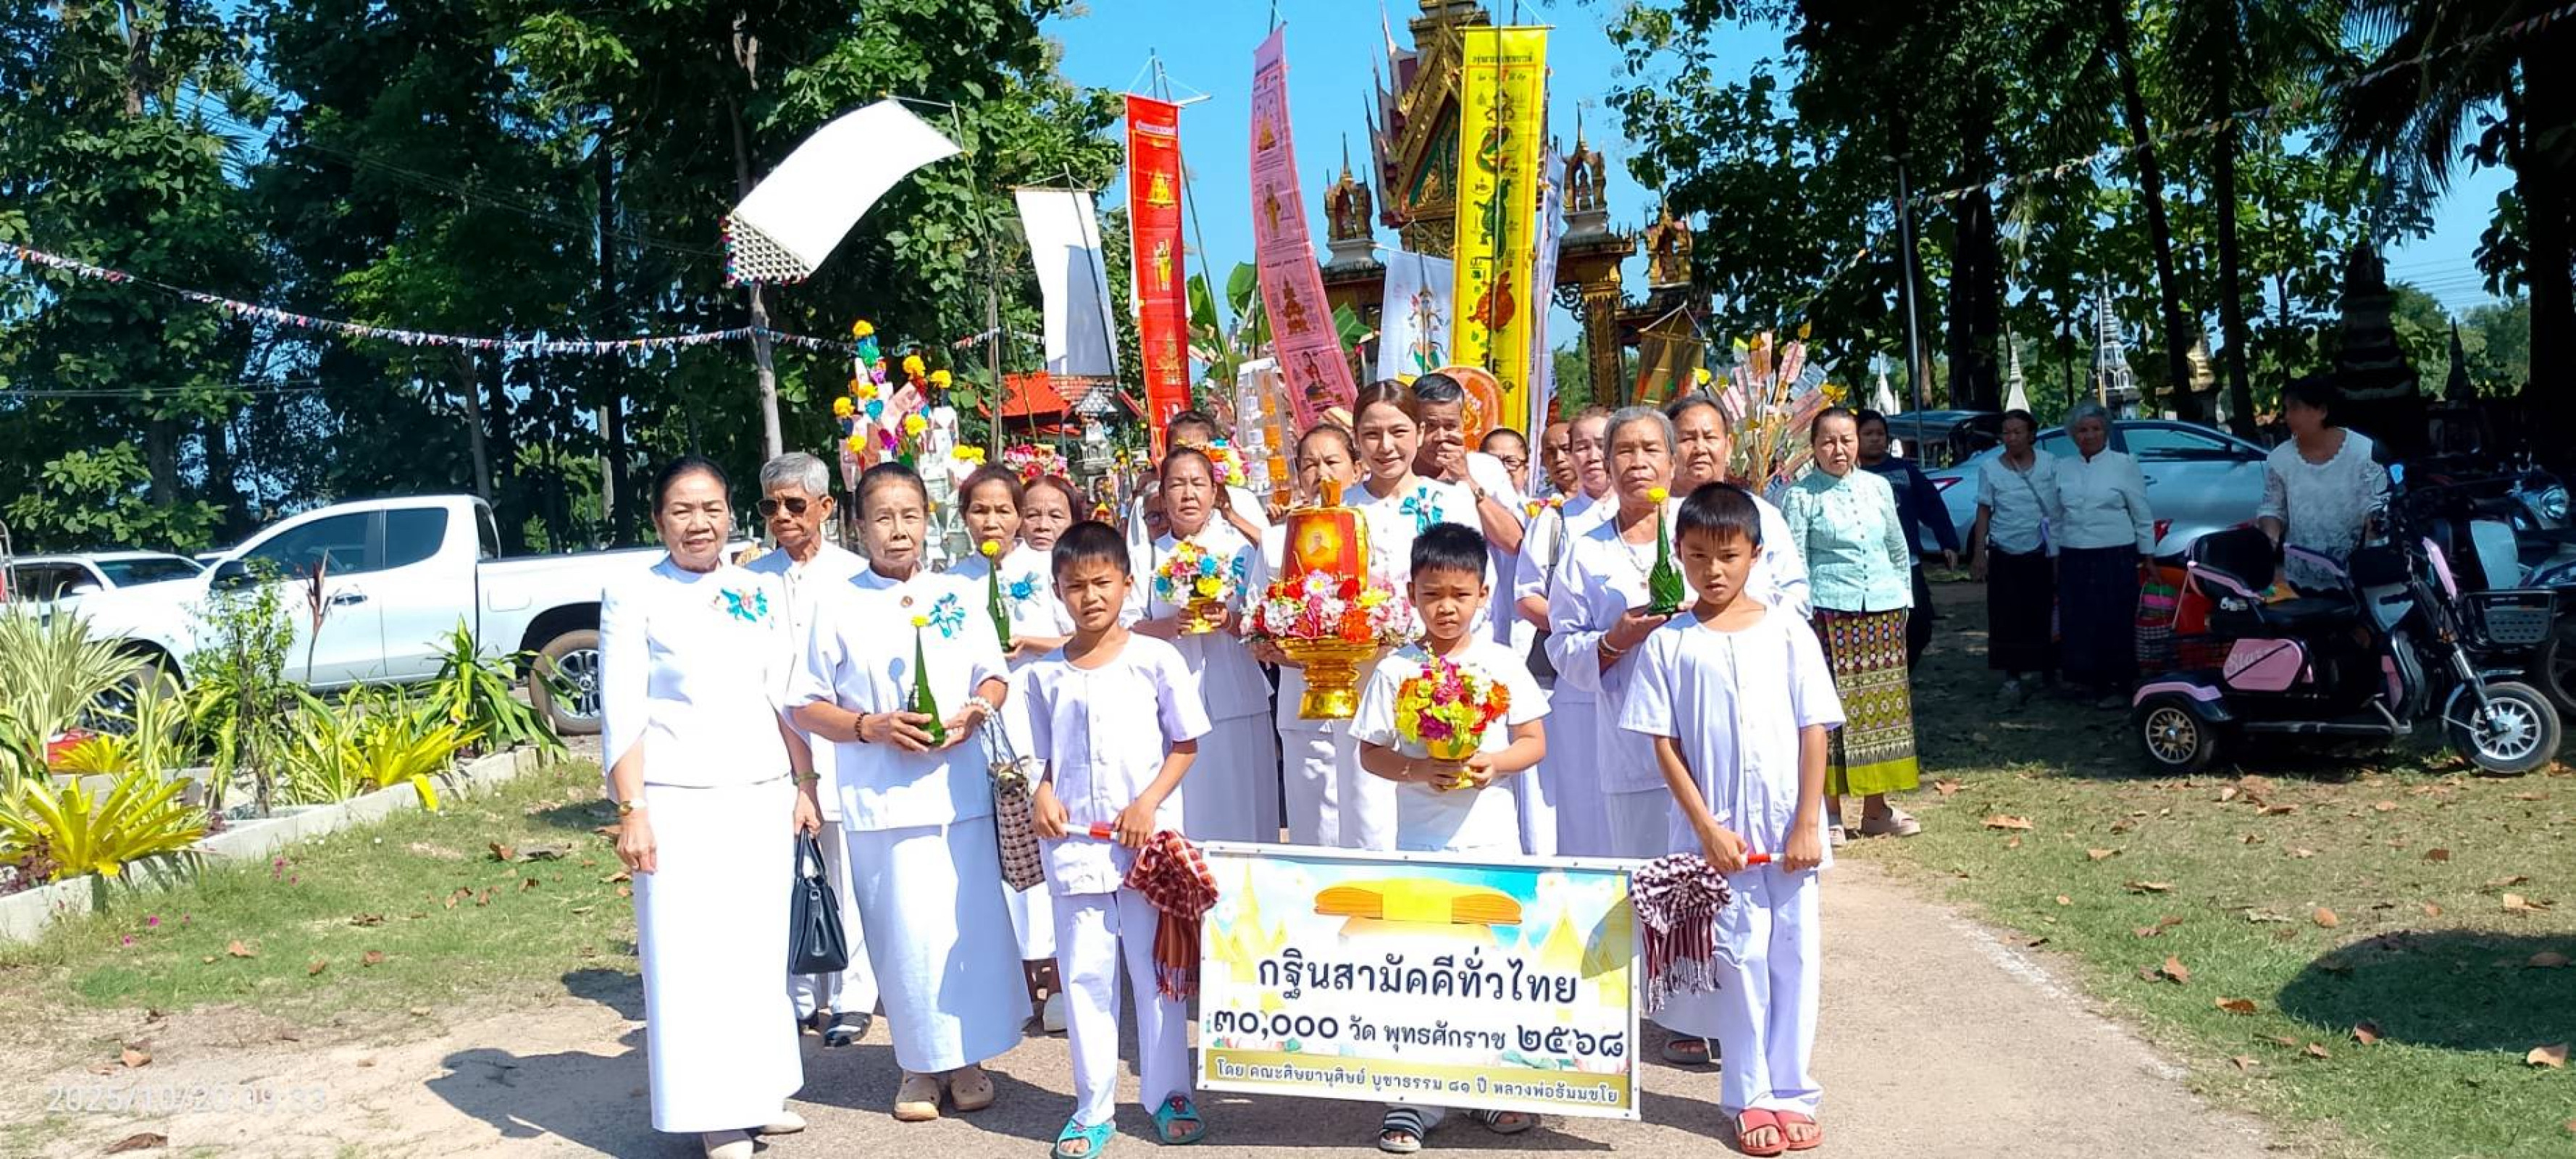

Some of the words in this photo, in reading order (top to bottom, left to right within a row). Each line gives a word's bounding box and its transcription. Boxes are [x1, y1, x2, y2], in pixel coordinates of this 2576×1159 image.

[1258, 946, 1577, 1003] กฐินสามัคคีทั่วไทย
[1213, 1009, 1339, 1041] ๓๐,๐๐๐
[1348, 1015, 1376, 1042] วัด
[1384, 1020, 1506, 1054] พุทธศักราช
[1517, 1023, 1624, 1058] ๒๕๖๘
[1217, 1058, 1244, 1077] โดย
[1250, 1063, 1366, 1088] คณะศิษยานุศิษย์
[1372, 1074, 1442, 1092] บูชาธรรม
[1449, 1081, 1471, 1093] ๘๑
[1477, 1076, 1487, 1094] ปี
